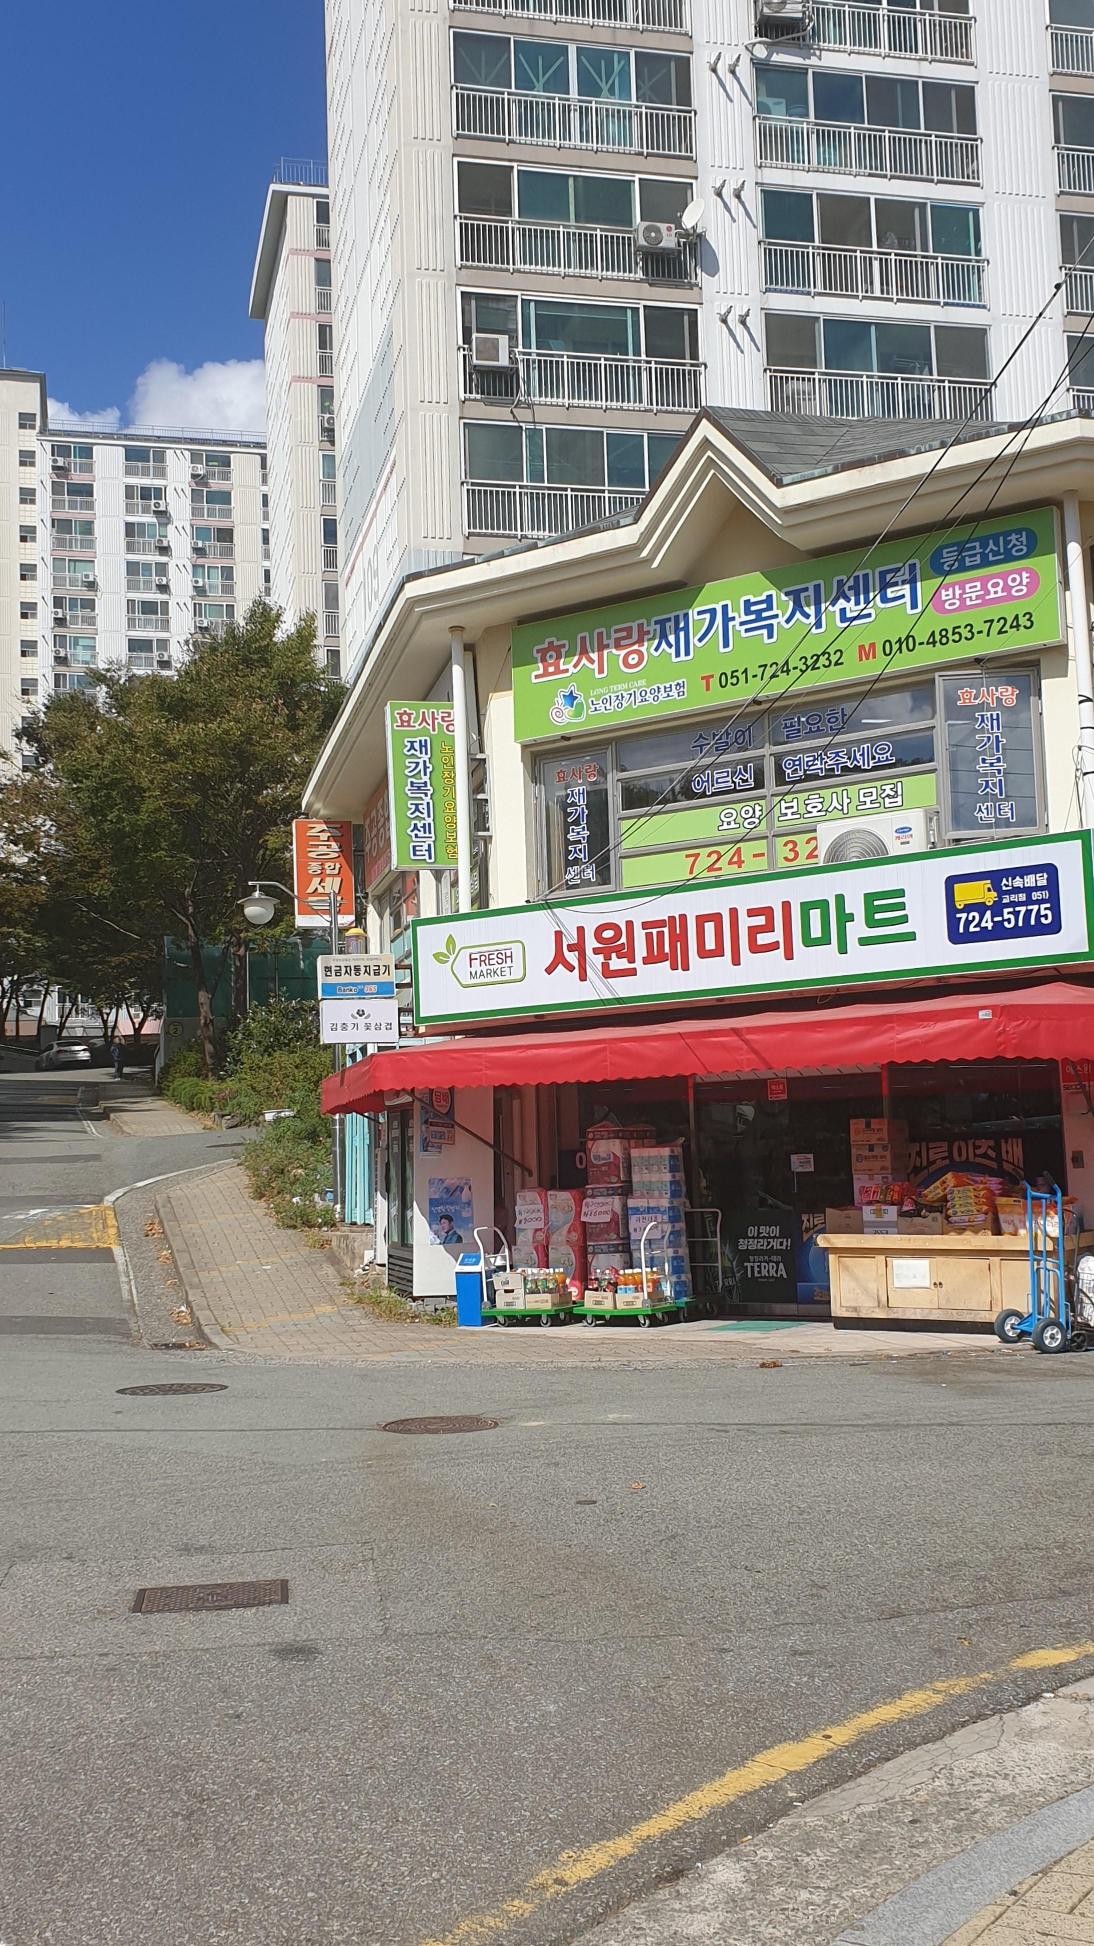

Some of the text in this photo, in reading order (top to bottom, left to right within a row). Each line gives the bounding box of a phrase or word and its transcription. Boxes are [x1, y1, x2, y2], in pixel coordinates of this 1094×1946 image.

[939, 531, 1028, 570] 등급신청
[940, 573, 1031, 610] 방문요양
[700, 611, 1034, 692] T 051-724-3232 M 010-4853-7243
[589, 680, 686, 713] 노인장기요양보험
[590, 679, 647, 696] LONG TERM CARE
[957, 686, 1019, 707] 효사랑
[691, 707, 848, 754] 수발이 필요한
[555, 763, 599, 783] 효사랑
[691, 742, 896, 795] 어르신 연락주세요
[404, 737, 434, 862] 재가복지센터
[857, 781, 903, 811] 모집
[306, 824, 342, 859] 주공
[307, 862, 342, 875] 종합
[1001, 872, 1048, 890] 신속배달
[956, 903, 1053, 934] 724-5775
[324, 964, 390, 977] 현금자동지급기
[469, 949, 513, 968] FRESH
[469, 966, 514, 980] MARKET
[738, 1239, 791, 1250] 청정라거다!
[744, 1262, 788, 1279] TERRA
